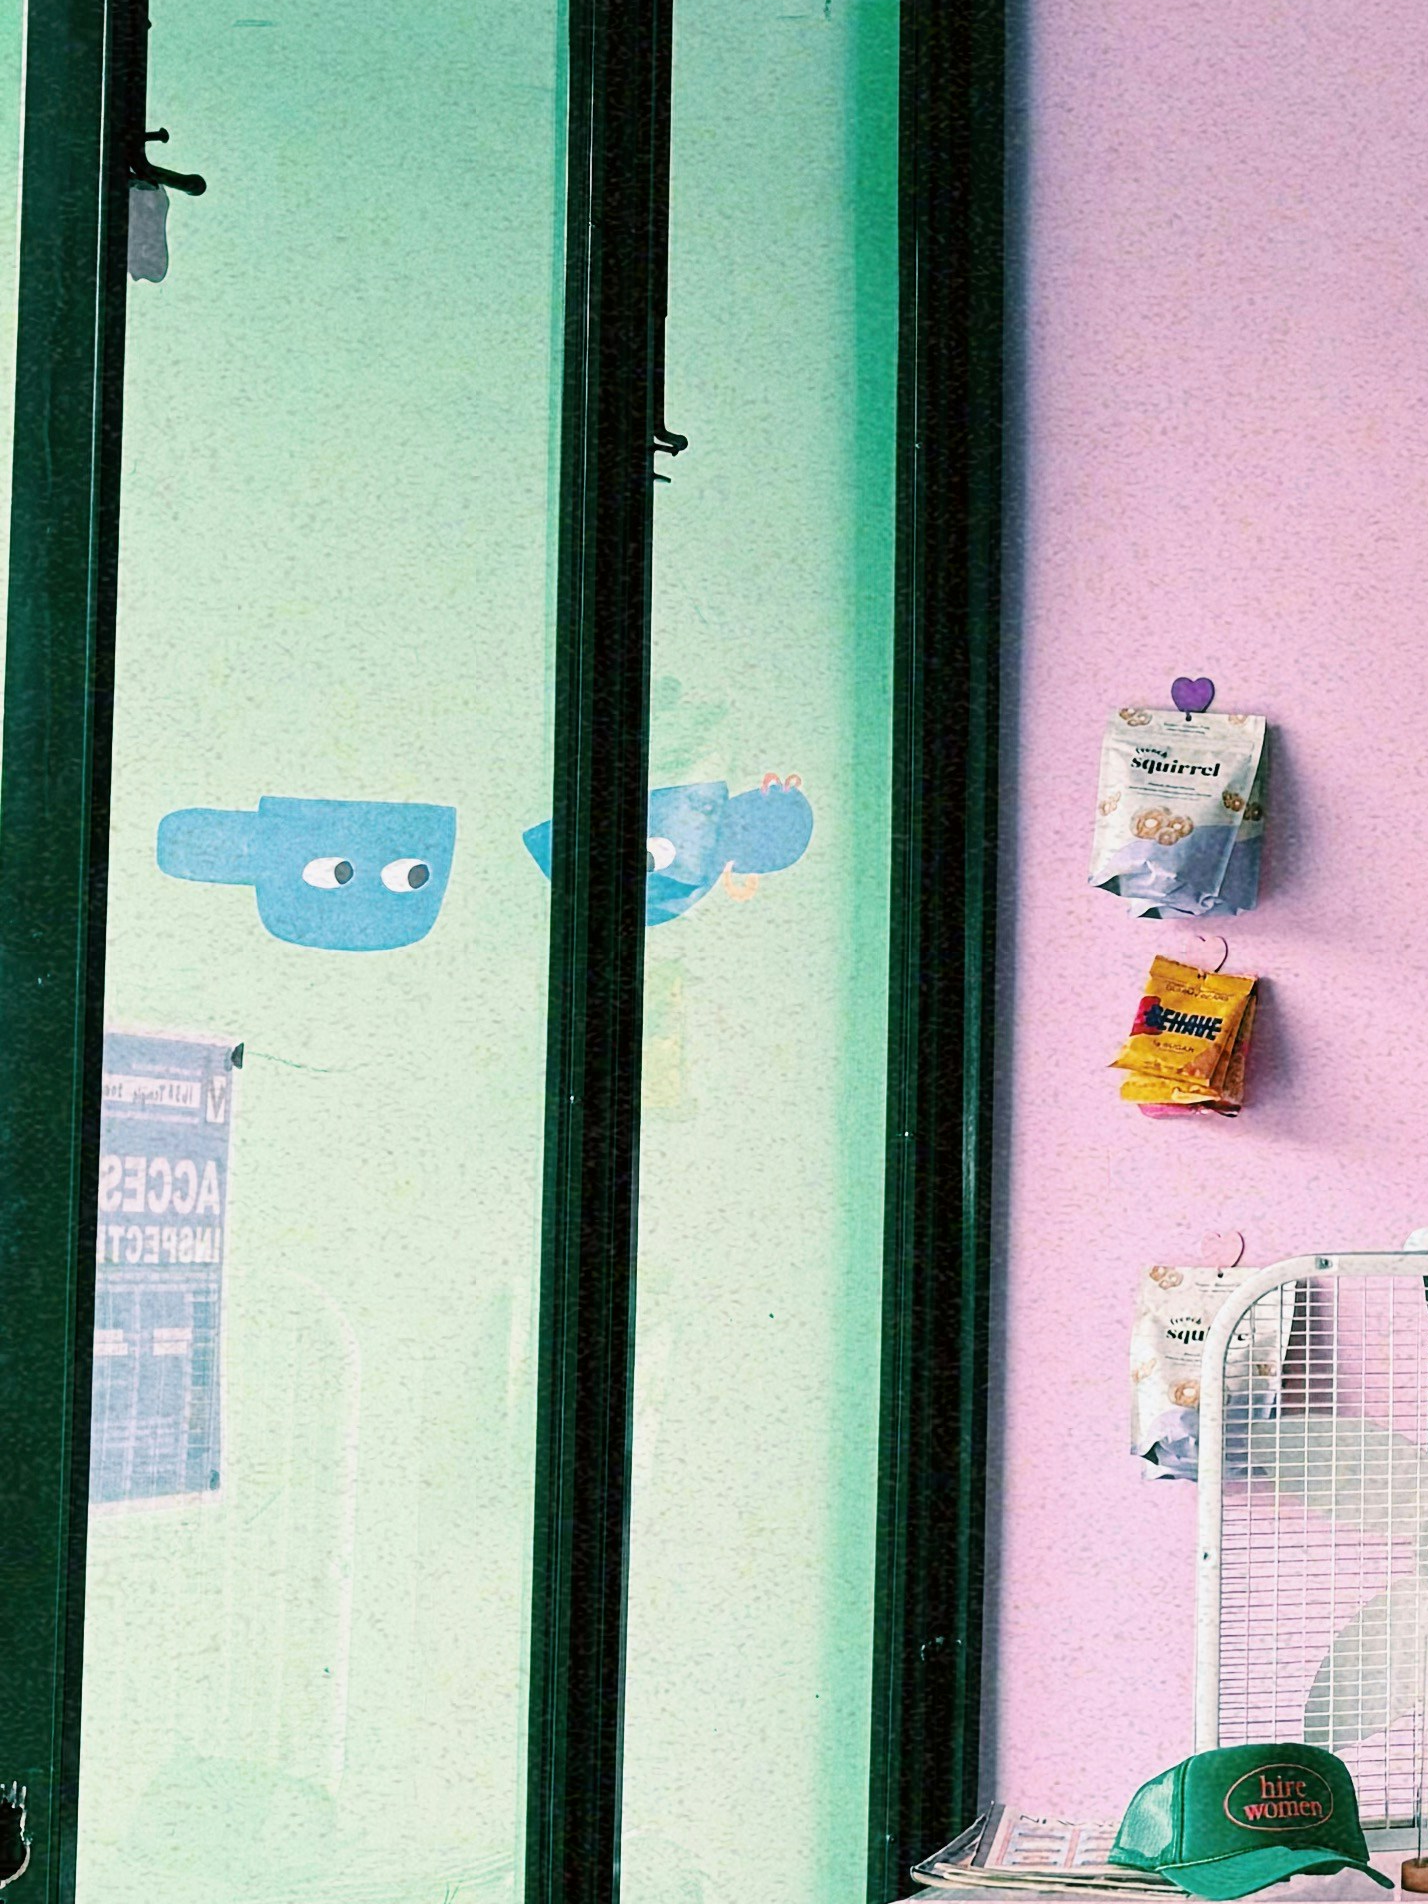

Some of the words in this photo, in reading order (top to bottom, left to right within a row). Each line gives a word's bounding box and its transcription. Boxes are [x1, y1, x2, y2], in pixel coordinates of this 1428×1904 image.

[1130, 757, 1221, 777] squirrel
[1144, 1004, 1223, 1041] BEHAVE
[1260, 1775, 1307, 1799] hire
[1243, 1800, 1323, 1821] women
